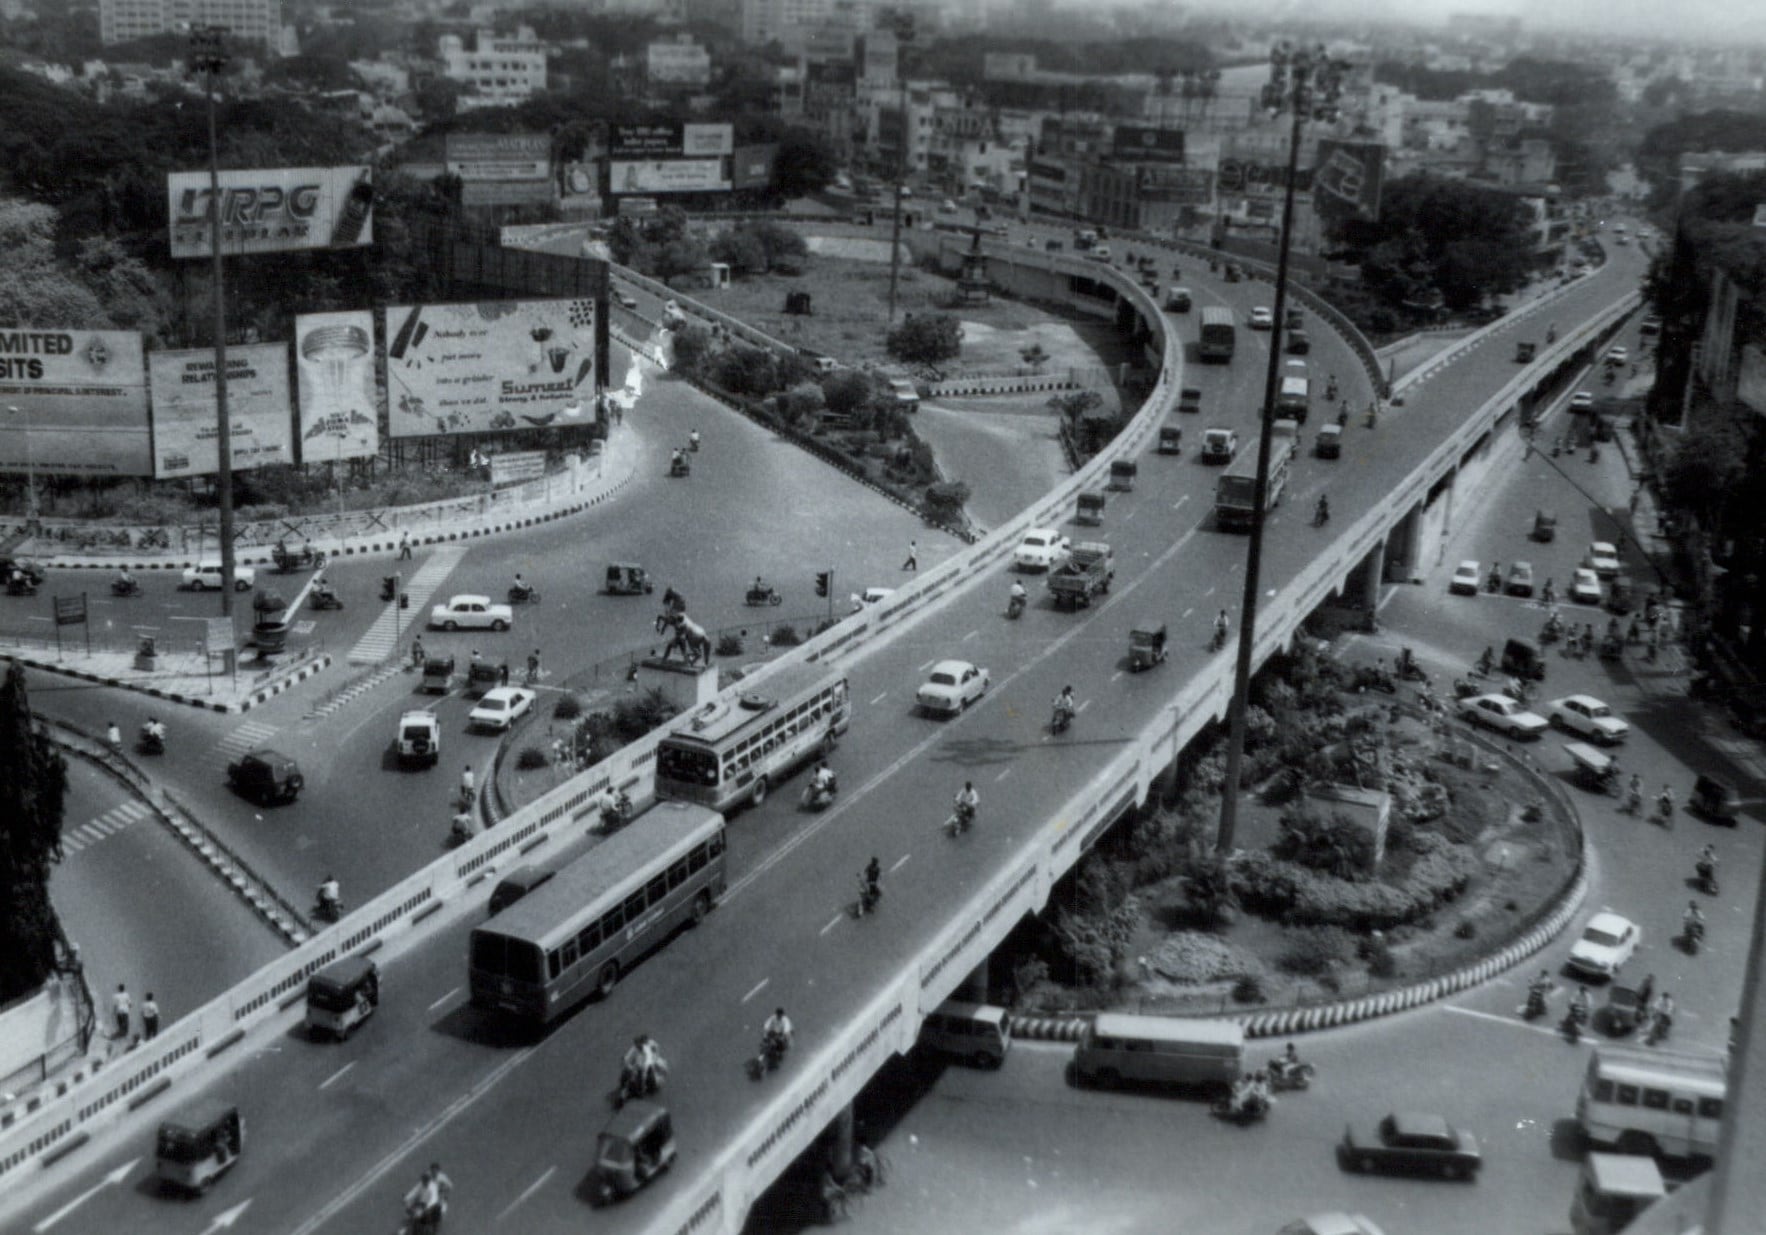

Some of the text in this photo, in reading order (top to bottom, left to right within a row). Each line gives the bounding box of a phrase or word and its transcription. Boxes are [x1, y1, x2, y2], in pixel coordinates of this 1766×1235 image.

[222, 185, 320, 225] RPG
[433, 329, 466, 339] Nobody
[462, 373, 495, 386] grinder
[501, 378, 574, 395] Sumeet
